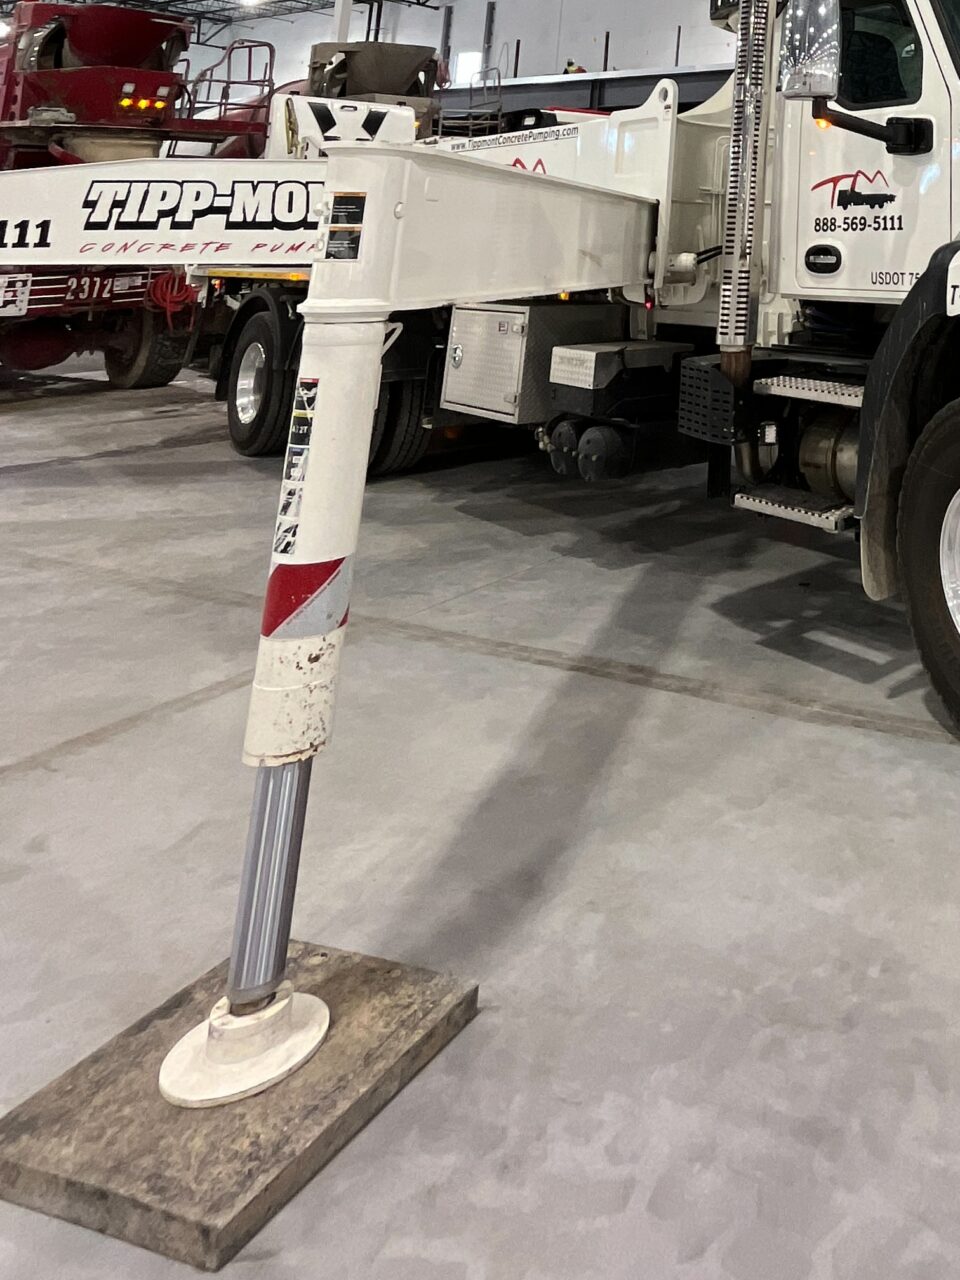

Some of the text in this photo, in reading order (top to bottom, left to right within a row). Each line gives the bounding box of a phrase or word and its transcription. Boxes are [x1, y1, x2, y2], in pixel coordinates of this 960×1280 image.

[813, 214, 904, 233] 888-569-5111
[79, 239, 233, 255] CONCRETE
[870, 271, 905, 286] USDOT
[65, 276, 113, 300] 2372
